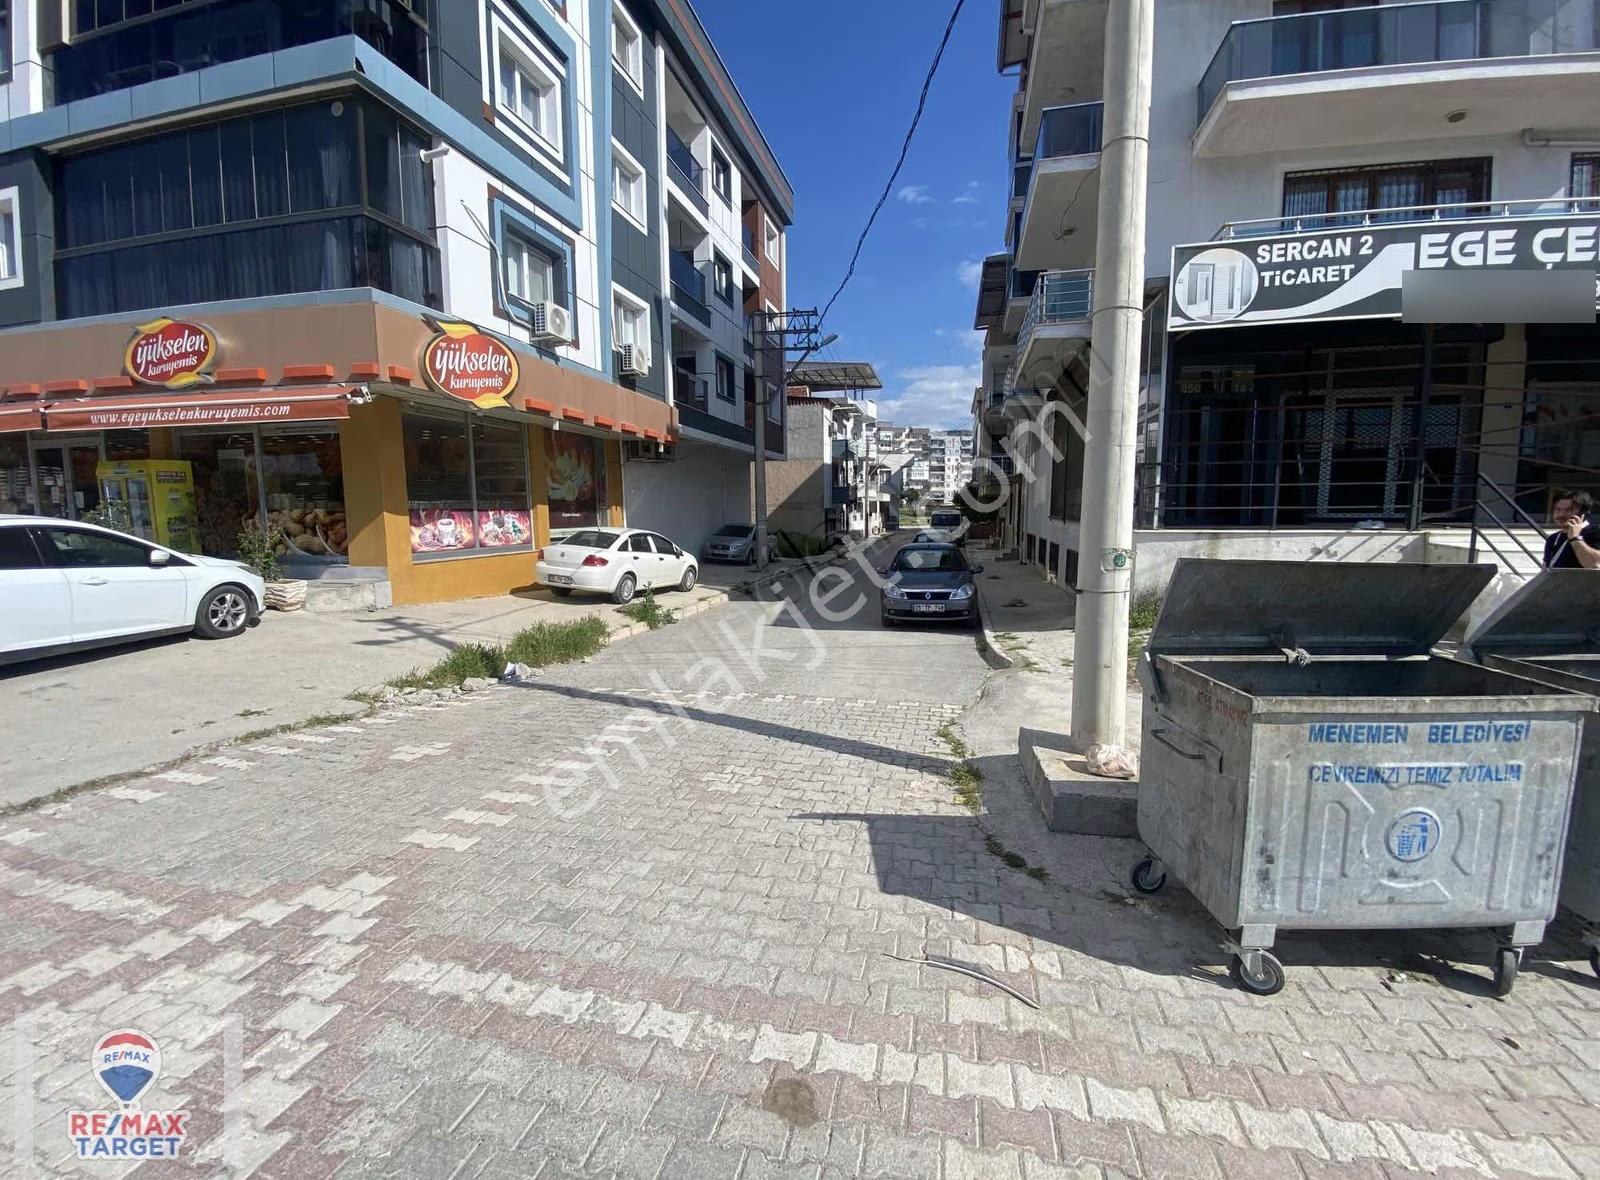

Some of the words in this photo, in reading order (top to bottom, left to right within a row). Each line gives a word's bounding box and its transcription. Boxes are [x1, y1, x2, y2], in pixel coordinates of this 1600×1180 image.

[1256, 237, 1352, 264] SERCAN
[1358, 234, 1373, 255] 2
[1419, 228, 1518, 269] EGE
[1532, 226, 1600, 270] ÇE
[1308, 723, 1409, 744] MENEMEN
